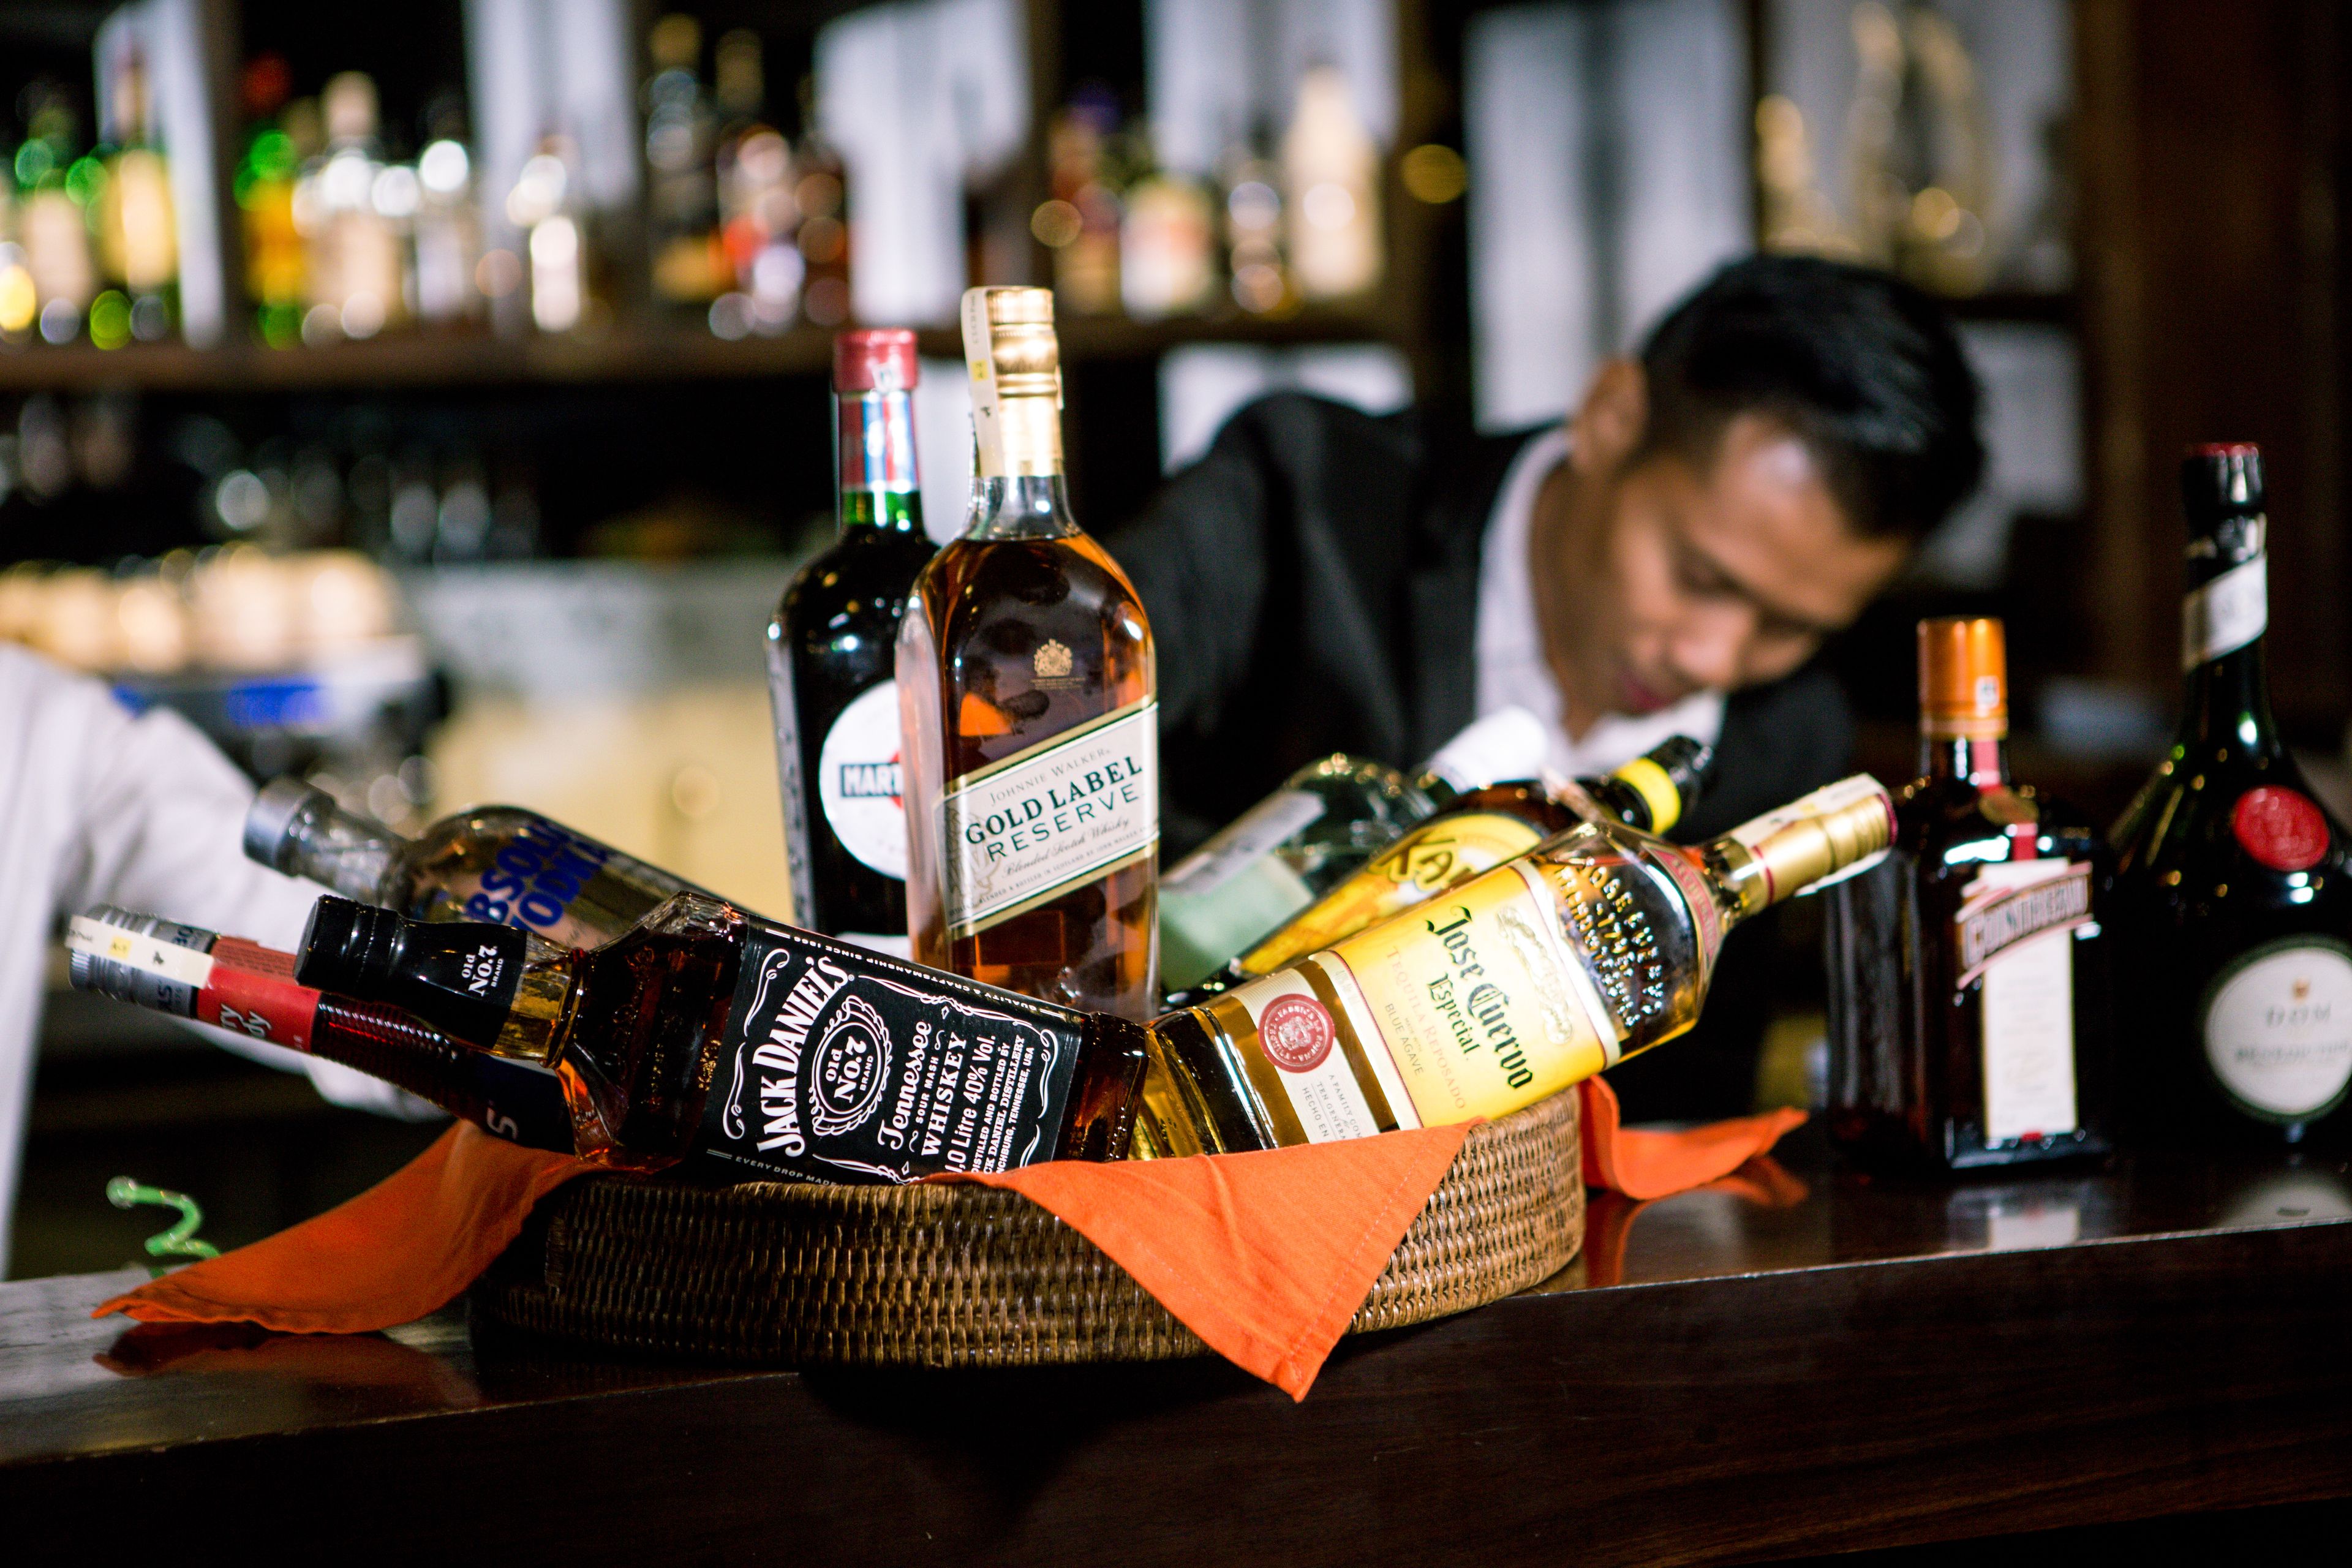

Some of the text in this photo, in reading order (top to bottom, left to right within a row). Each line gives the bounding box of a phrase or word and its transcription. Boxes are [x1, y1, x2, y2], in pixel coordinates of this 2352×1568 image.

[965, 756, 1143, 845] GOLD LABEL
[989, 748, 1106, 807] JOHNNIE WALKER
[986, 783, 1140, 863] RESERVE
[1001, 850, 1050, 878] Blended
[1051, 836, 1086, 858] Scotch
[1089, 818, 1130, 842] Whisky
[461, 954, 476, 978] Old
[794, 936, 821, 948] 1866
[825, 945, 862, 960] SINCE
[491, 957, 504, 987] BRAND
[866, 958, 970, 992] CRAFTSMANSHIP
[984, 992, 1037, 1011] QUALITY
[1425, 905, 1533, 1090] Jose Cuervo
[1385, 1003, 1424, 1076] BLUE AGAVE
[1427, 972, 1481, 1054] Especial
[825, 1049, 843, 1082] Old
[859, 1055, 874, 1091] BRAND
[971, 1035, 997, 1061] Vol.
[877, 1021, 932, 1150] Tennessee
[915, 1056, 940, 1124] SOUR MASH
[921, 1031, 967, 1156] WHISKEY
[963, 1065, 989, 1104] 40%
[971, 1042, 1011, 1174] DISTILLED AND BOTTLED BY
[982, 1033, 1025, 1174] CK DANIEL DISTILLERY
[996, 1046, 1035, 1174] NCHBURG, TENNESSEE, USA
[1302, 1087, 1329, 1137] HECHO EN
[1317, 1081, 1346, 1140] TEN GENERA
[1333, 1082, 1353, 1116] FAMILY
[1350, 1117, 1363, 1138] COM
[756, 1075, 805, 1157] JACK
[951, 1107, 978, 1148] Litre
[735, 1155, 772, 1170] EVERY
[773, 1165, 804, 1178] DROP
